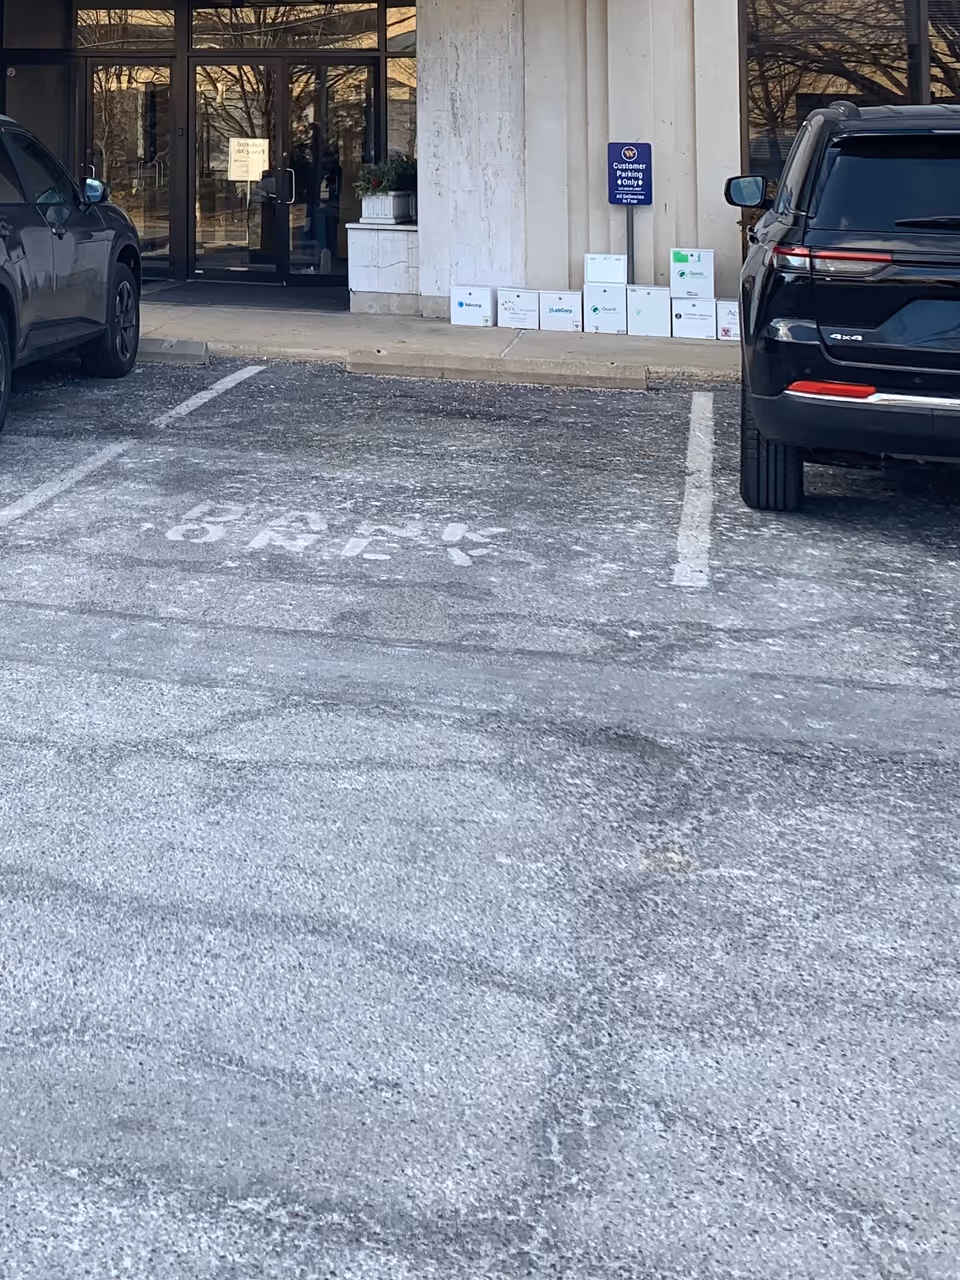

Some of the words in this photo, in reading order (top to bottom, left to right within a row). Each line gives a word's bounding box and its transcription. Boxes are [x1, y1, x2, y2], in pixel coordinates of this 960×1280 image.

[612, 162, 646, 170] Customer
[616, 170, 643, 179] Parking
[622, 178, 638, 187] Only
[829, 333, 863, 341] 4x4
